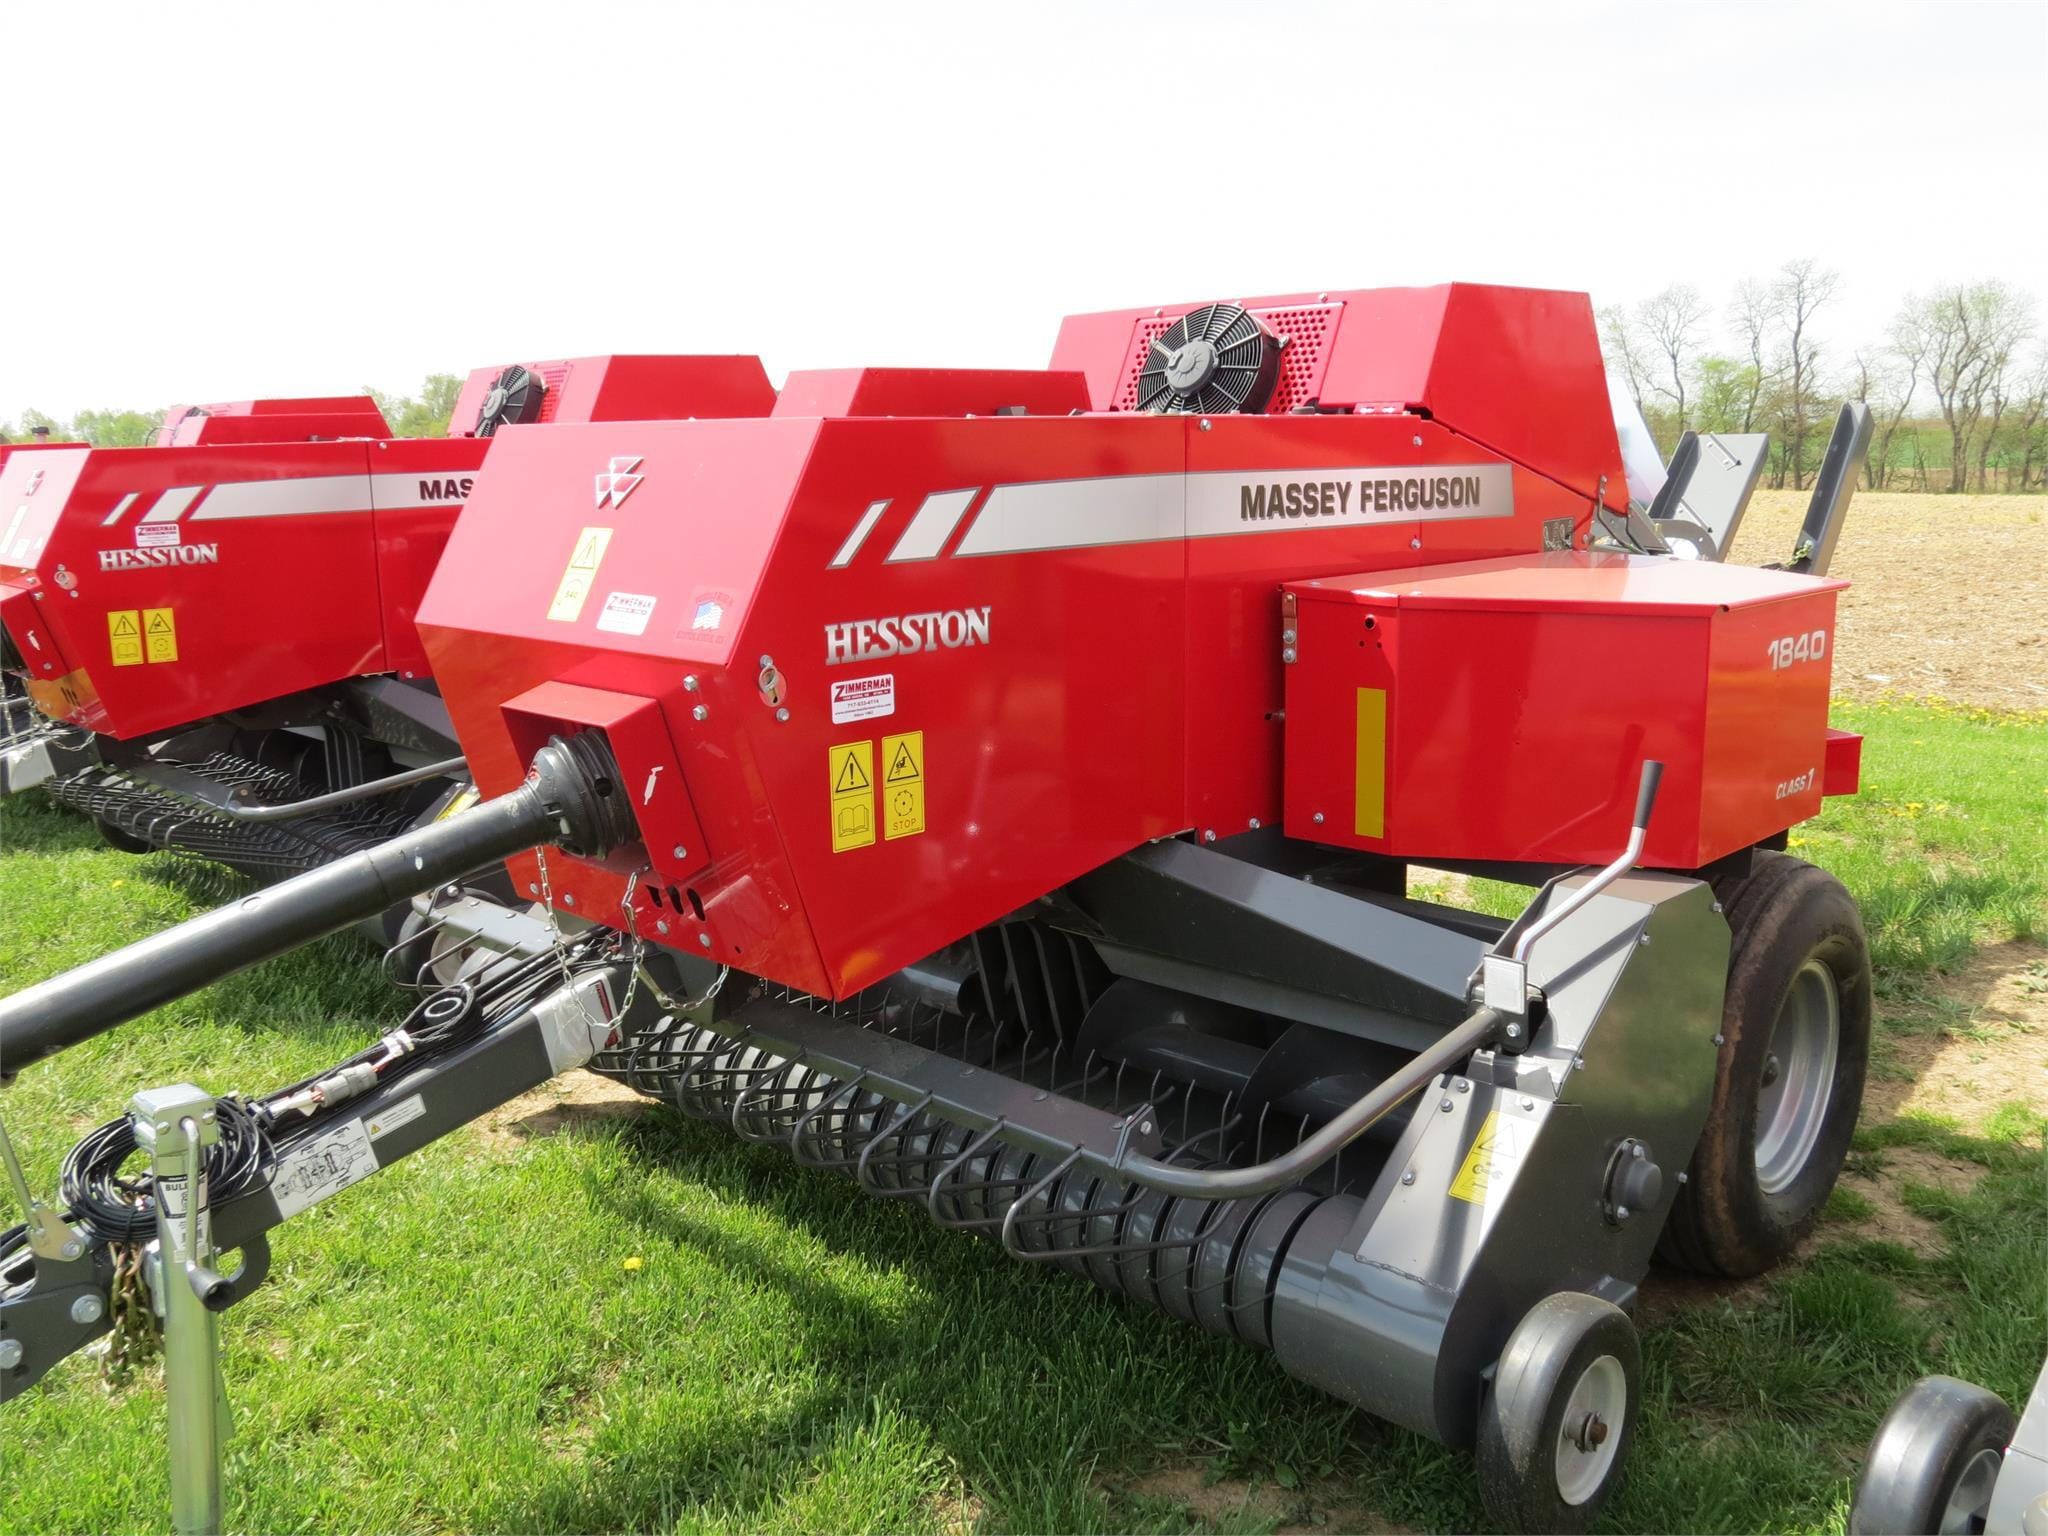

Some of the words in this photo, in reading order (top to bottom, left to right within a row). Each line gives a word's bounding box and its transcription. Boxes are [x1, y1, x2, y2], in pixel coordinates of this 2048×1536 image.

[419, 478, 474, 500] MAS
[1240, 481, 1352, 521] MASSEY
[1360, 476, 1481, 513] FERGUSON
[98, 543, 218, 571] HESSTON
[824, 605, 992, 666] HESSTON
[1768, 629, 1826, 671] 1840
[834, 677, 892, 703] ZIMMERMAN
[1776, 777, 1807, 800] CLASS
[1807, 768, 1815, 792] 1
[892, 818, 917, 832] STOP
